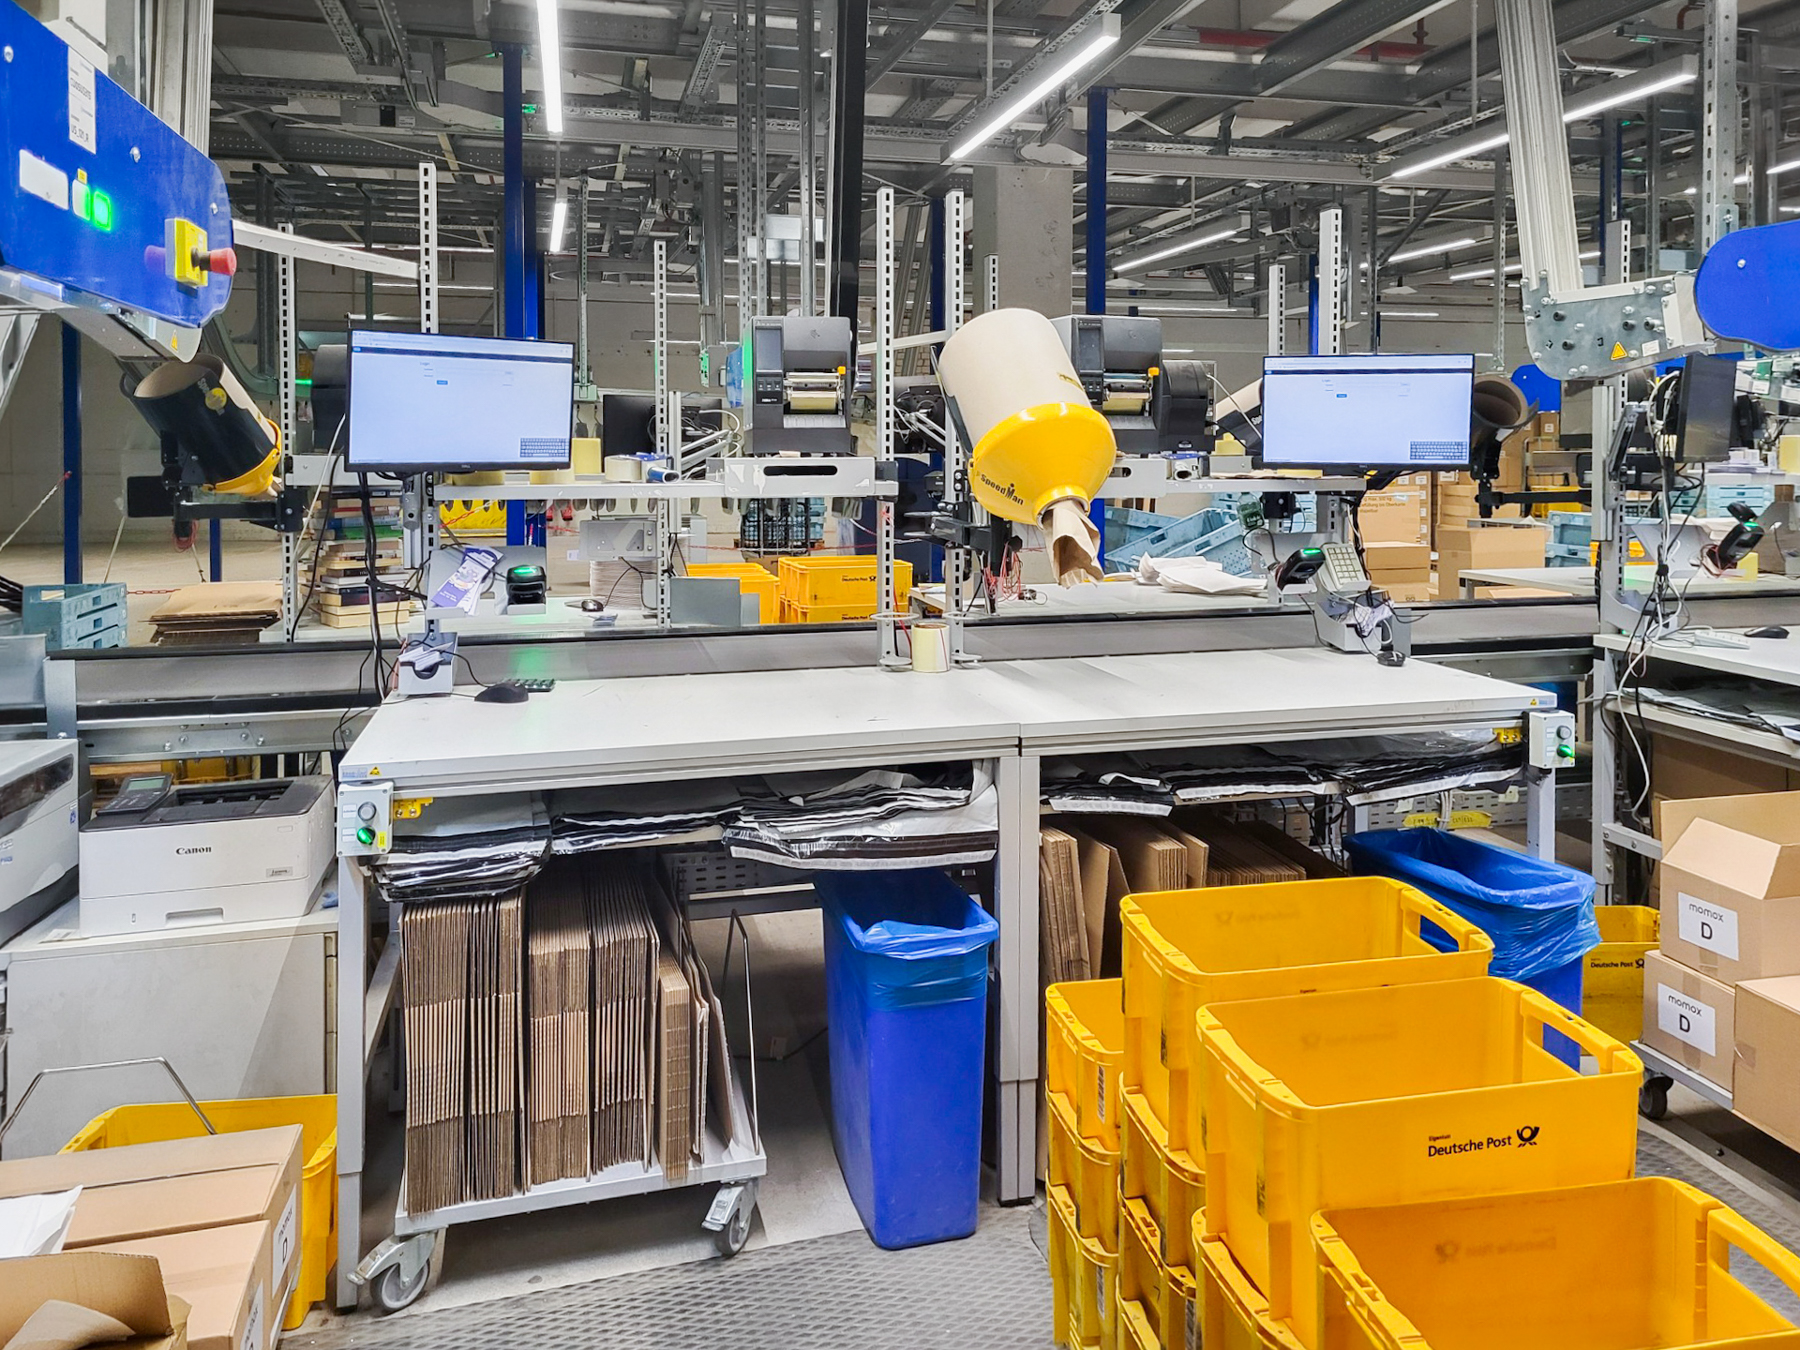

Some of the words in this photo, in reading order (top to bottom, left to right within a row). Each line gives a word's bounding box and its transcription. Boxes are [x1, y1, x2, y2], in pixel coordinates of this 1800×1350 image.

[980, 473, 1024, 506] SpeedMan
[175, 845, 212, 855] Canon
[1689, 902, 1724, 923] momox
[1701, 921, 1713, 940] D
[1668, 994, 1703, 1017] momox
[1679, 1013, 1691, 1033] D
[1428, 1139, 1484, 1158] Deutsche
[1486, 1135, 1512, 1150] Post
